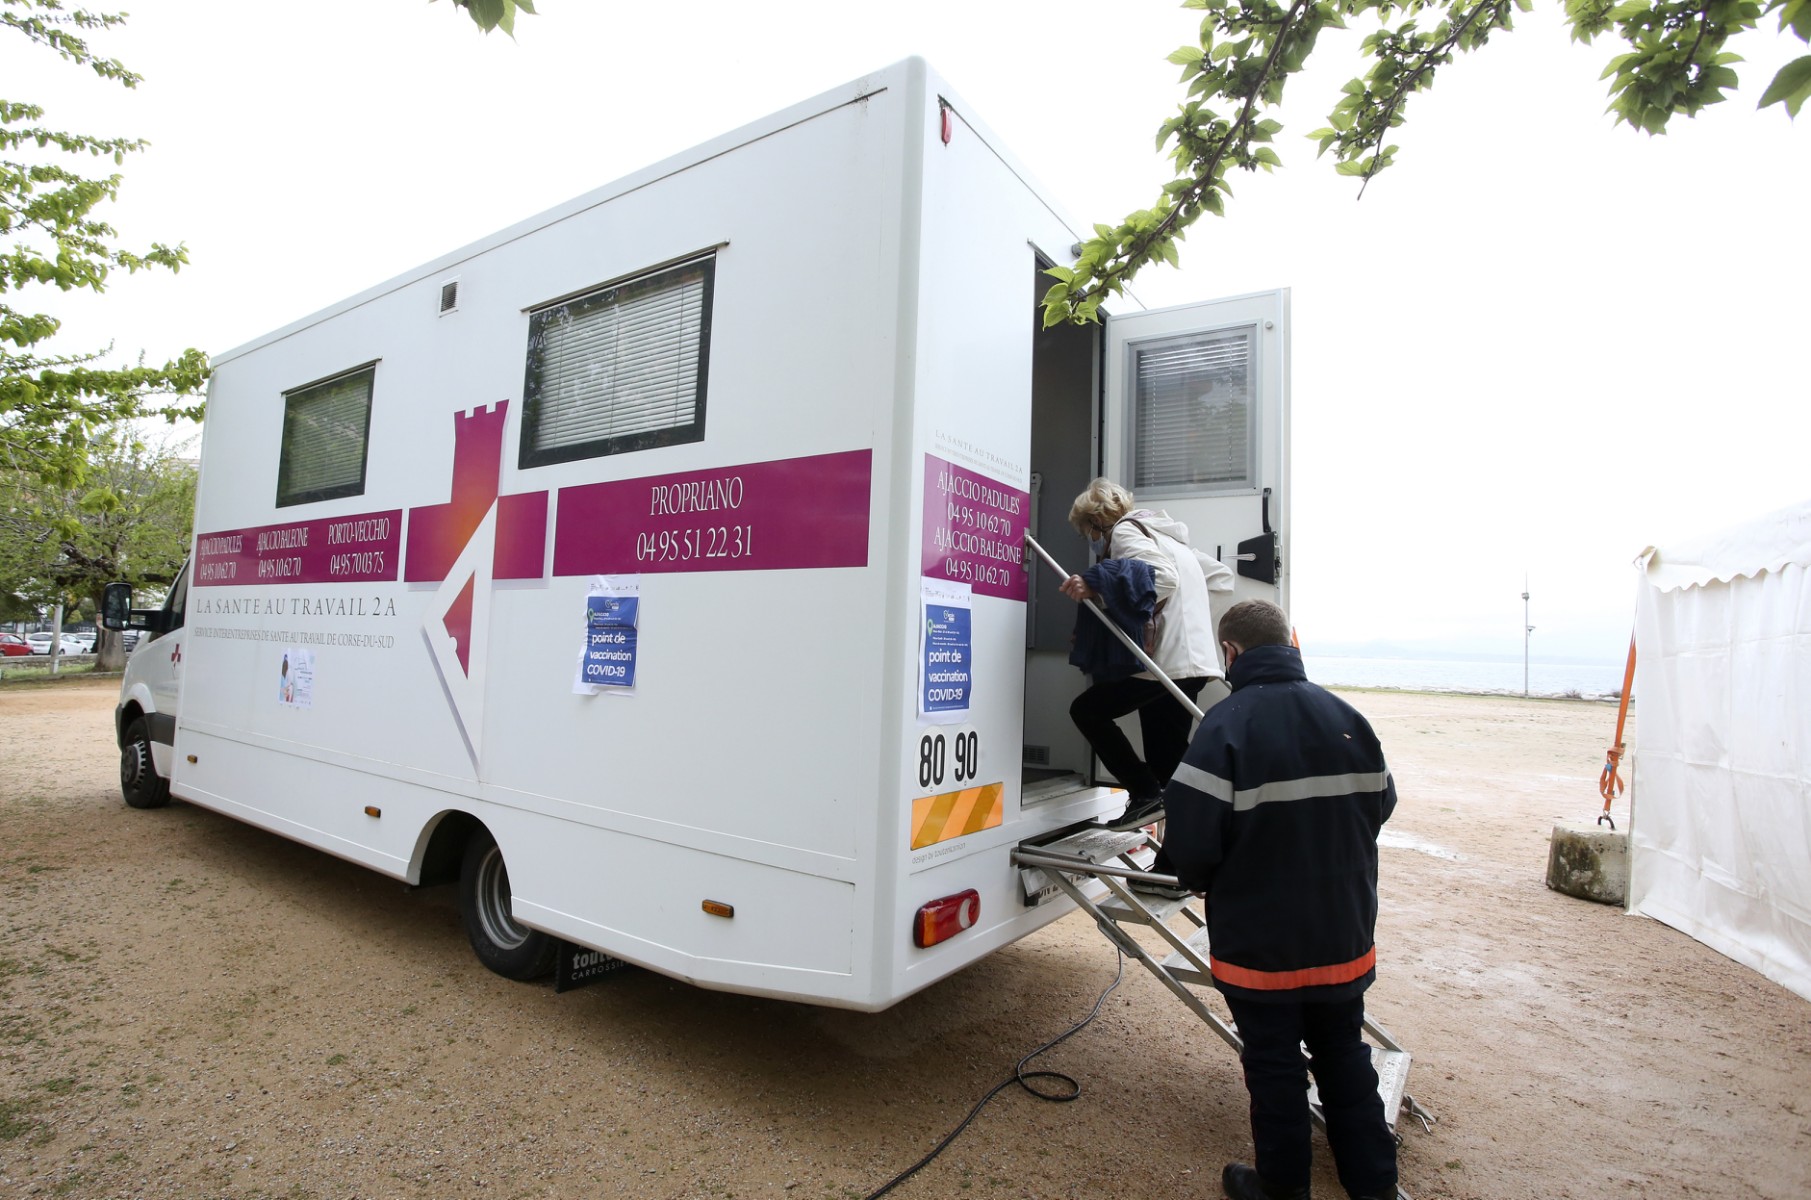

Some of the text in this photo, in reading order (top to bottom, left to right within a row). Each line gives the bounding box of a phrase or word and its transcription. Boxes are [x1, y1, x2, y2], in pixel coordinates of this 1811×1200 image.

[936, 430, 946, 440] LA
[948, 436, 972, 452] SANTE
[974, 448, 984, 457] AU
[986, 452, 1014, 470] TRAVAIL
[650, 476, 743, 516] PROPRIANO
[937, 470, 980, 502] AJACCIO
[982, 486, 1020, 515] PADULES
[328, 518, 389, 545] PORTO-VECCHIO
[948, 502, 1011, 537] 04 95 10 62 70
[256, 531, 280, 556] AJACCIO
[637, 525, 752, 562] 04 95 51 22 31
[934, 526, 1021, 564] AJACCIO BALÉONE
[258, 557, 302, 578] 04 95 10 62 70
[330, 551, 384, 575] 04 95 70 03 75
[946, 558, 1010, 587] 04 95 10 62 70
[196, 596, 396, 616] LA SANTE AU TRAVAIL 2A
[300, 632, 326, 645] TRAVAIL
[327, 633, 336, 645] DE
[337, 633, 394, 648] CORSE-DU-SUD
[592, 632, 626, 646] point de
[590, 649, 632, 661] vaccination
[929, 648, 962, 666] point de
[587, 664, 626, 677] COVID-19
[928, 669, 968, 683] vaccination
[928, 688, 963, 702] COVID-19
[920, 734, 946, 788] 80
[955, 731, 978, 782] 90
